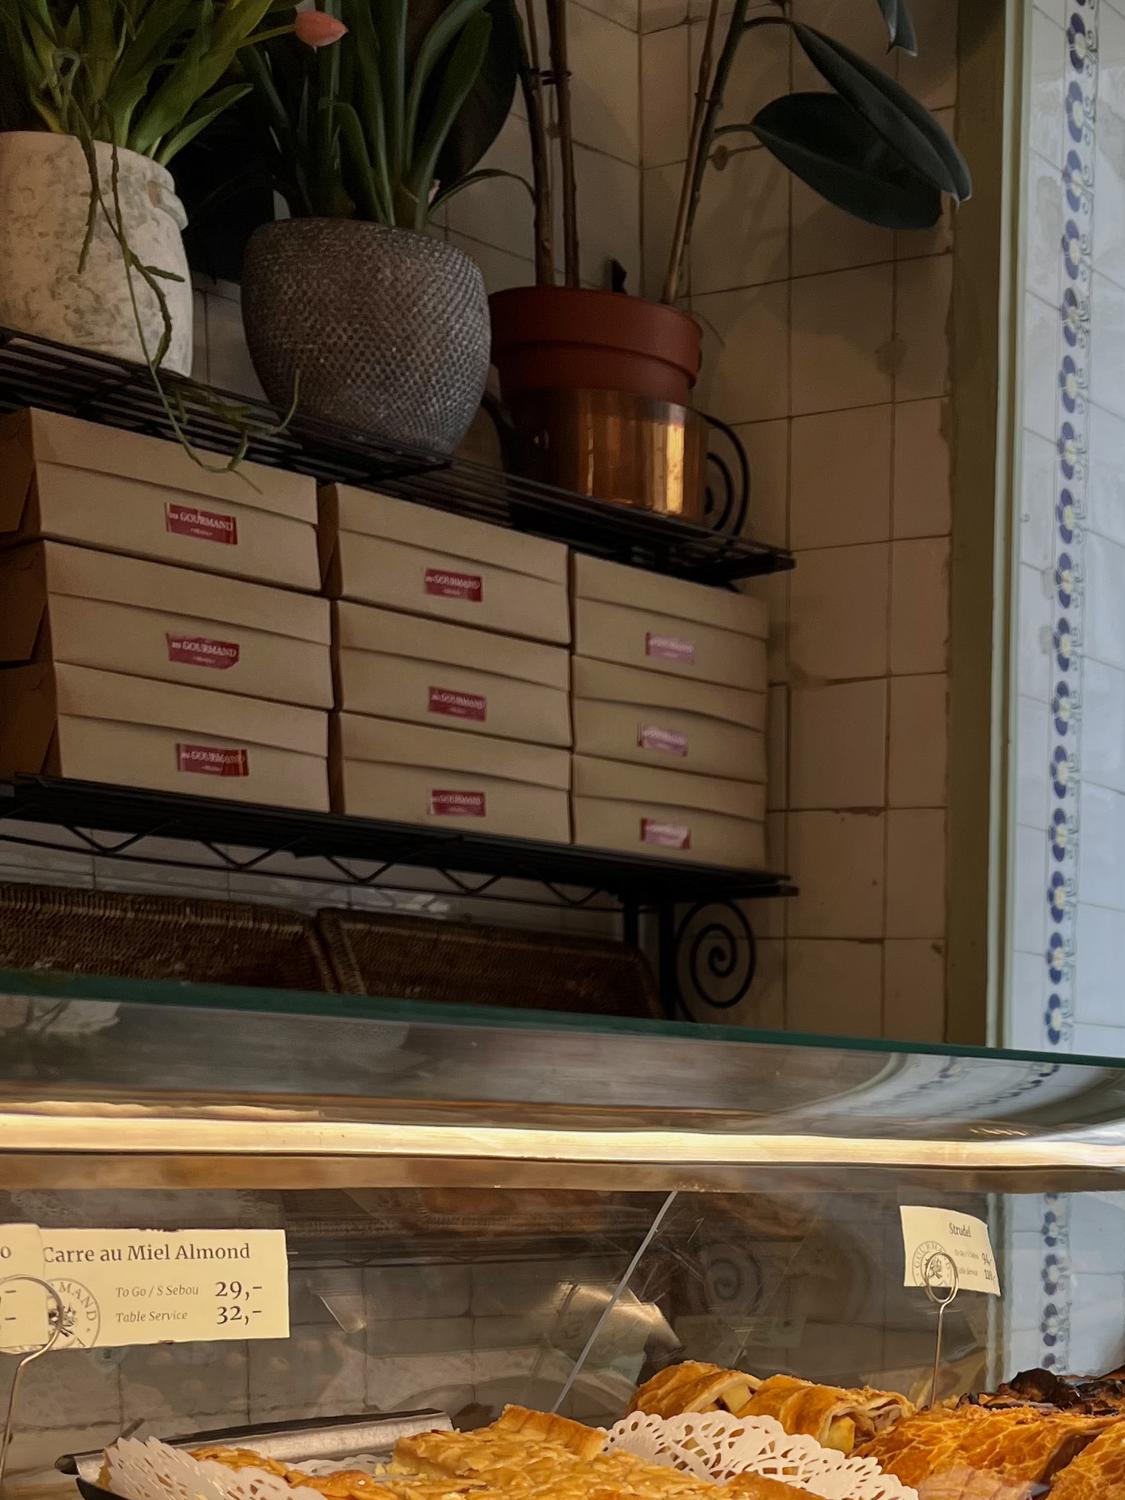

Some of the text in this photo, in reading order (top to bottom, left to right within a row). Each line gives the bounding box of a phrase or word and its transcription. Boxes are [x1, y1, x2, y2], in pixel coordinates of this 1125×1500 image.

[949, 1222, 971, 1237] Strudel
[43, 1242, 251, 1264] Carre au Miel Almond
[115, 1280, 264, 1301] To Go / S Sebou 29,-
[116, 1305, 263, 1327] Table Service 32,-
